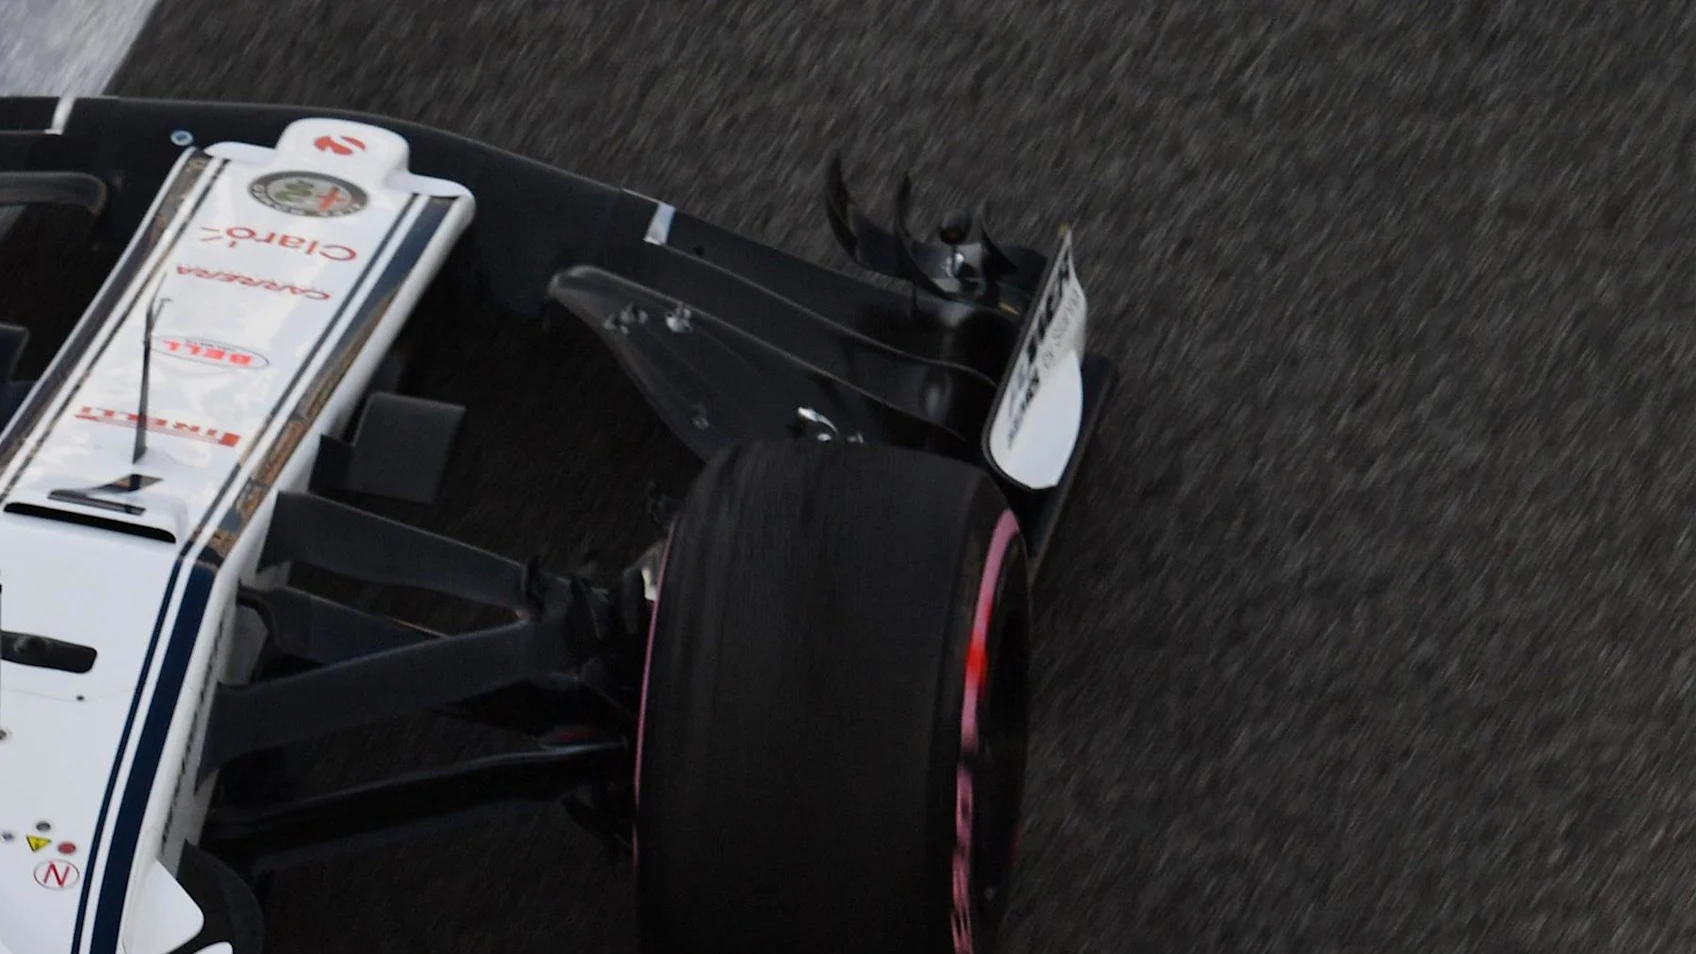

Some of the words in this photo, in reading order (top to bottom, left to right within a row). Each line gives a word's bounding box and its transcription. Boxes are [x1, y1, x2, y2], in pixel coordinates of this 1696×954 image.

[225, 226, 357, 262] Claro
[174, 263, 331, 302] CARRERA
[159, 338, 254, 367] BELL
[43, 861, 71, 888] N
